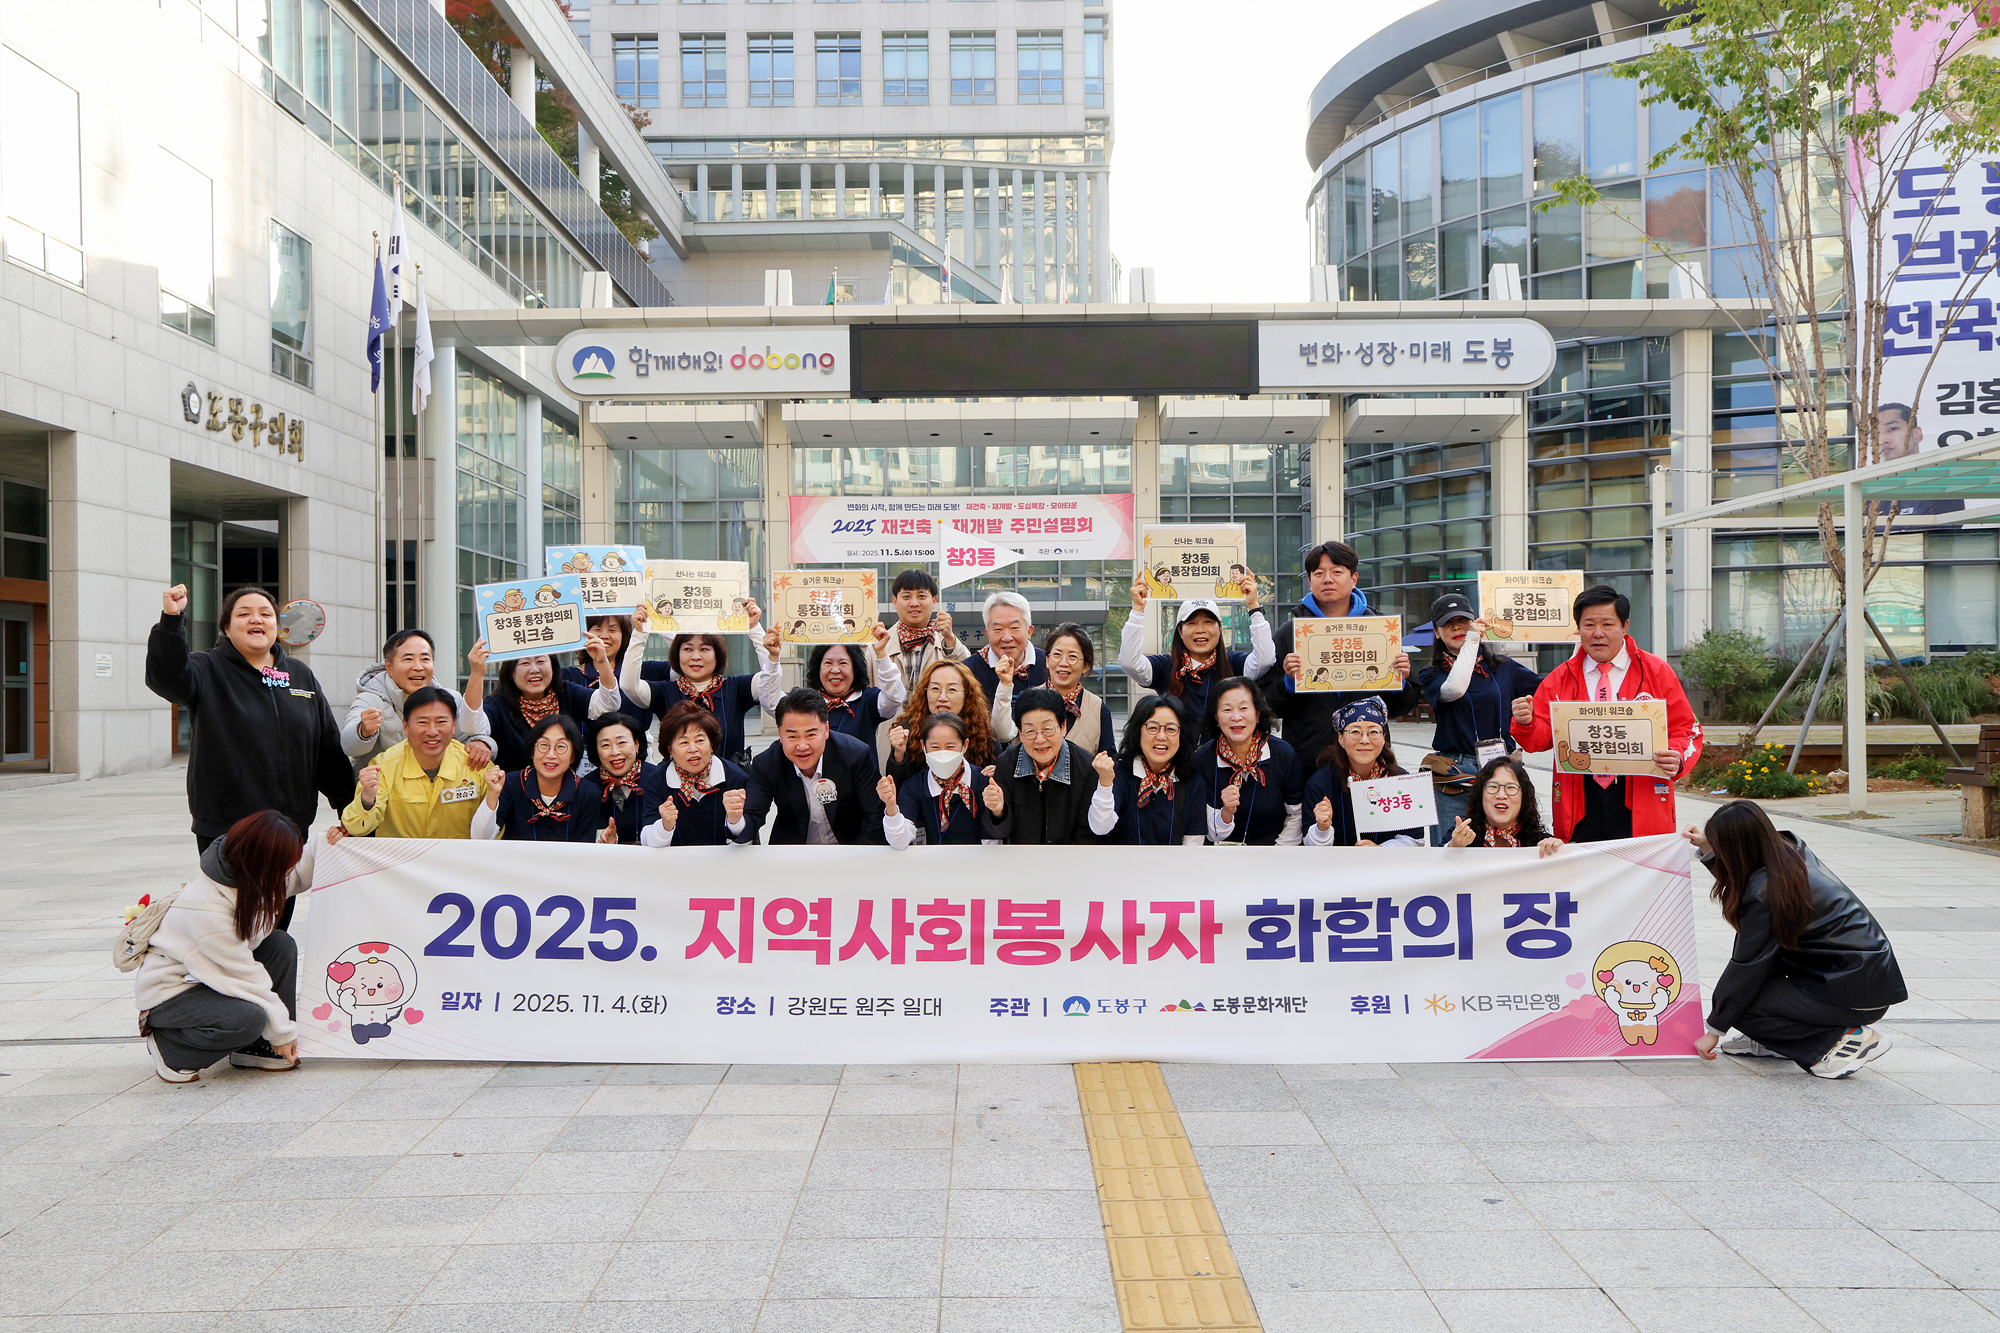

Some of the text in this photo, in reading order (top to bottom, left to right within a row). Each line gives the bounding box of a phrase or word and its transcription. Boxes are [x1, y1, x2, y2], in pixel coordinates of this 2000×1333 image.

[1463, 338, 1514, 370] 도봉
[629, 345, 835, 377] 함께해요! dobong
[206, 390, 304, 461] 도봉구의회
[847, 503, 960, 512] 변화의 시작, 함께 만드는 미래 도봉!
[992, 502, 1012, 510] 재개발
[1018, 502, 1045, 510] 도심복합
[831, 517, 1093, 536] 2025 재건축 재개발 주민설명회
[1173, 537, 1214, 545] 신나는 워크숍
[946, 547, 996, 567] 창3동
[1181, 553, 1210, 564] 창3동
[675, 570, 695, 578] 신나는
[1171, 565, 1221, 577] 통장협의회
[590, 576, 637, 588] 통장협의회
[802, 577, 821, 585] 즐거운
[1504, 576, 1553, 585] 화이팅! 워크숍
[683, 585, 713, 597] 창3동
[672, 597, 723, 610] 통장협의회
[1512, 592, 1547, 606] 창3동
[494, 609, 573, 631] 창3동 통장협의회
[1502, 608, 1561, 621] 통장협의회
[1325, 623, 1344, 633] 즐거운
[513, 627, 555, 645] 워크숍
[1332, 637, 1363, 650] 창3동
[1319, 650, 1377, 664] 통장협의회
[1579, 706, 1634, 716] 화이팅! 워크숍
[1588, 725, 1628, 739] 창3동
[1577, 741, 1644, 755] 통장협의회
[1377, 793, 1413, 813] 창3동
[423, 891, 1578, 965] 2025. 지역사회봉사자 화합의 장
[440, 992, 482, 1012] 일자
[715, 996, 756, 1016] 장소
[788, 996, 847, 1017] 강원도
[855, 996, 895, 1017] 원주
[902, 996, 942, 1017] 일대
[989, 997, 1030, 1017] 주관
[1097, 997, 1148, 1015] 도봉구
[1212, 995, 1308, 1014] 도봉문화재단
[1350, 994, 1391, 1015] 후원
